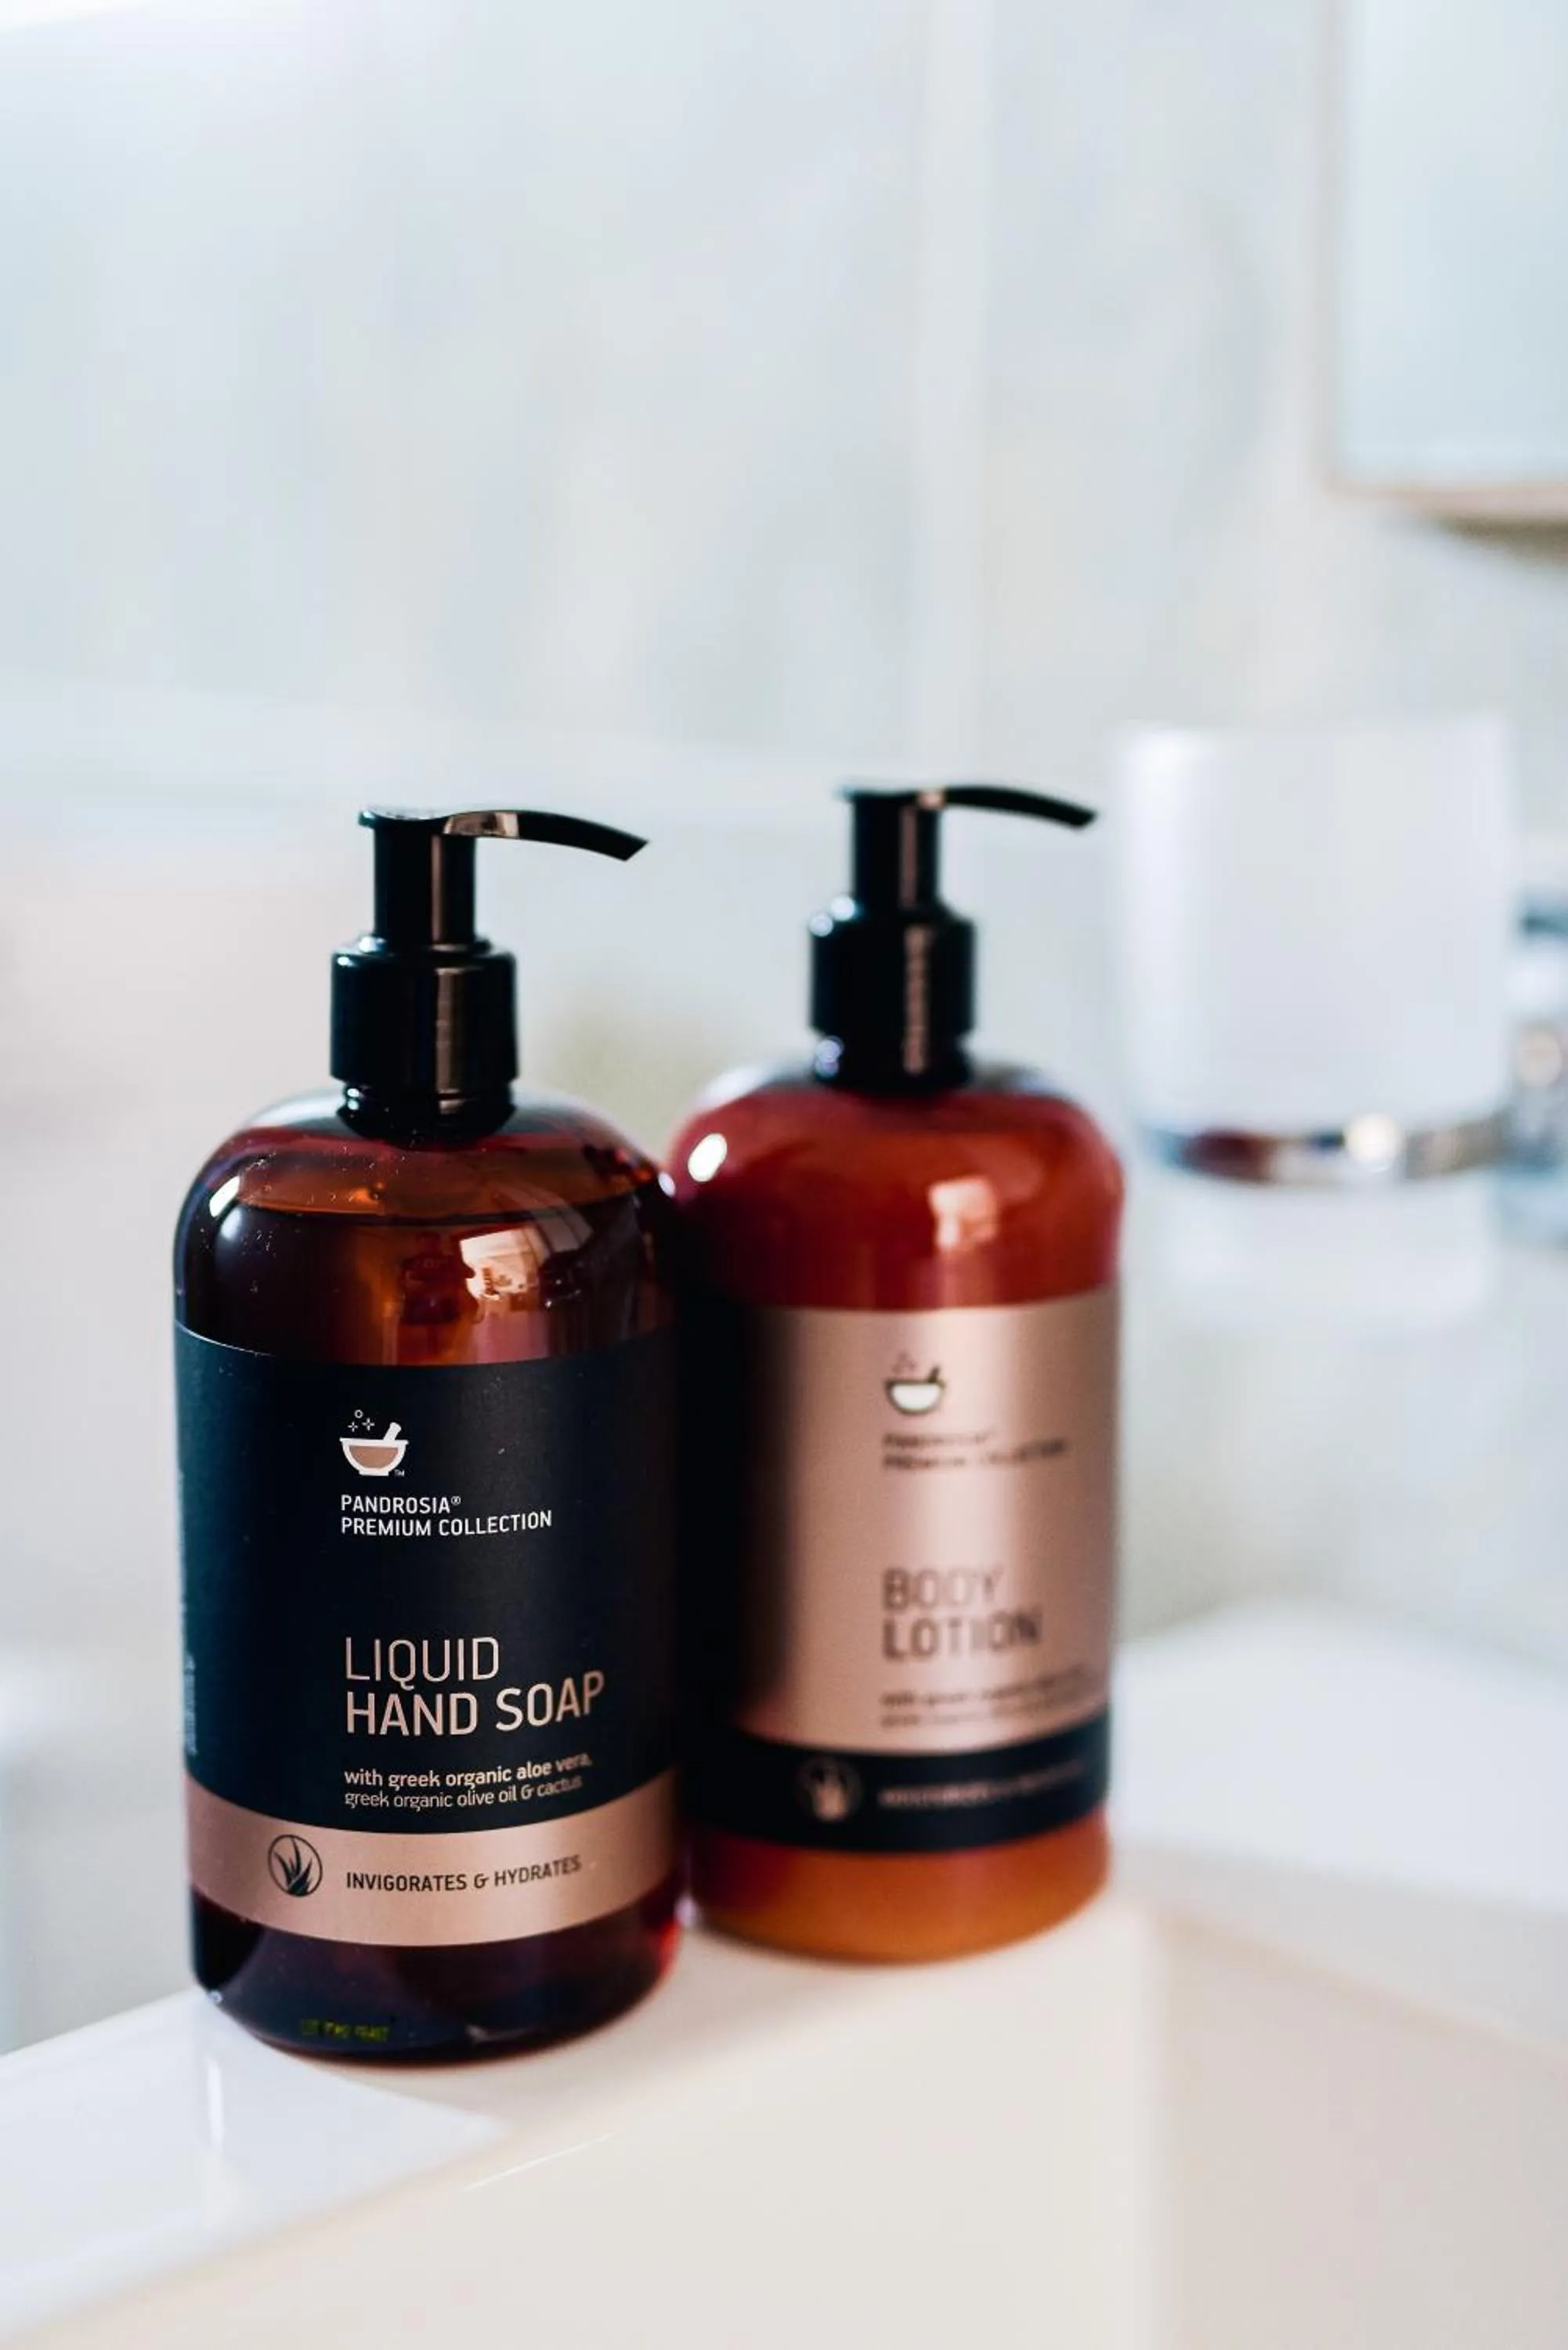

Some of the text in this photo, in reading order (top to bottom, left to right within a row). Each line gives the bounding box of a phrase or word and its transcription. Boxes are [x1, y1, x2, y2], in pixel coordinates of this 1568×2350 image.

[341, 1510, 552, 1536] PREMIUM COLLECTION
[883, 1567, 1004, 1611] BODY
[882, 1607, 1042, 1661] LOTION
[345, 1636, 500, 1690] LIQUID
[346, 1670, 605, 1736] HAND SOAP
[344, 1768, 383, 1787] with
[388, 1770, 440, 1791] greek
[445, 1766, 511, 1790] organic
[516, 1761, 552, 1780] aloe
[345, 1775, 583, 1811] greek organic olive oil & cactus
[346, 1854, 583, 1892] INVIGORATES & HYDRATES
